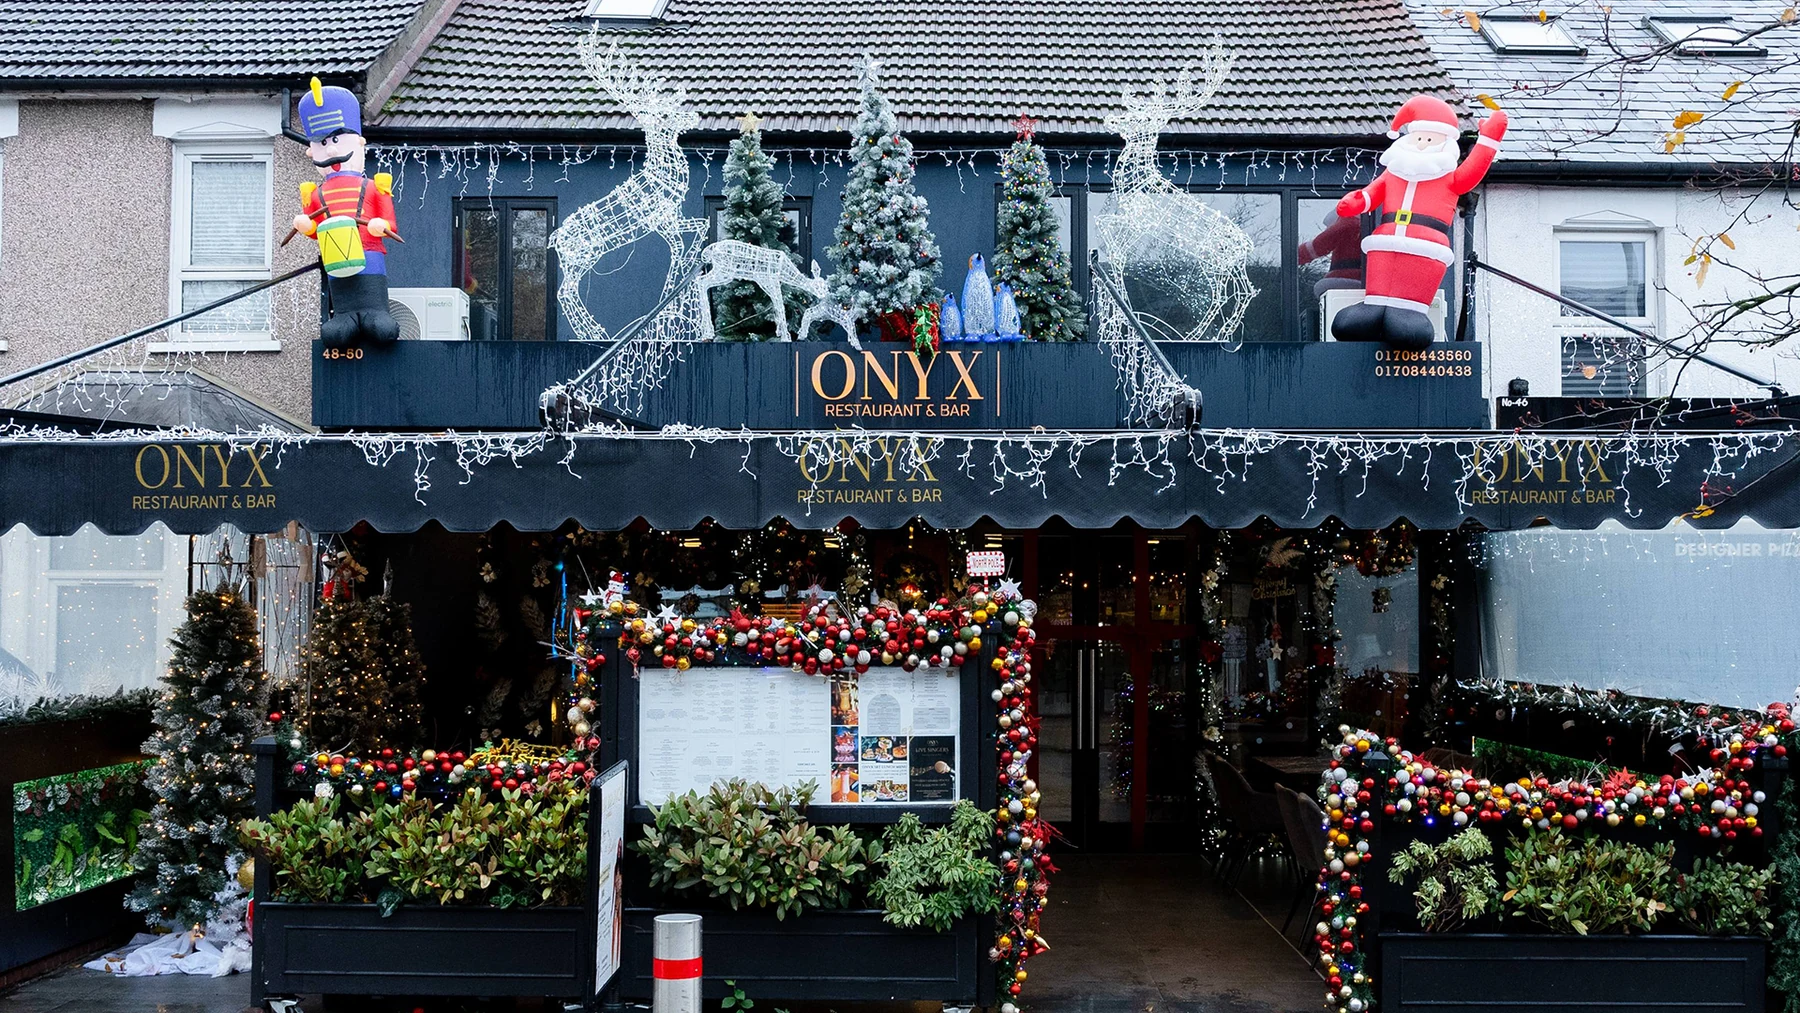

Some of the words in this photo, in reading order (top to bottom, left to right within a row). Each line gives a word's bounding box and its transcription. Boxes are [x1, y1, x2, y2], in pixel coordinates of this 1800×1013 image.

[322, 348, 364, 360] 48-50
[1375, 350, 1472, 362] 01708443560
[811, 351, 984, 400] ONYX
[1375, 365, 1472, 377] 01708440438
[825, 403, 922, 417] RESTAURANT
[925, 403, 936, 417] &
[940, 403, 970, 417] BAR
[134, 444, 273, 489] ONYX
[799, 438, 939, 483] ONYX
[1472, 439, 1612, 483] ONYX
[132, 495, 228, 510] RESTAURANT
[231, 495, 242, 508] &
[246, 494, 276, 508] BAR
[797, 489, 893, 503] RESTAURANT
[897, 489, 908, 503] &
[912, 488, 942, 502] BAR
[1472, 490, 1567, 504] RESTAURANT
[1571, 491, 1581, 504] &
[1585, 490, 1615, 504] BAR
[1675, 543, 1762, 556] DESIGNER
